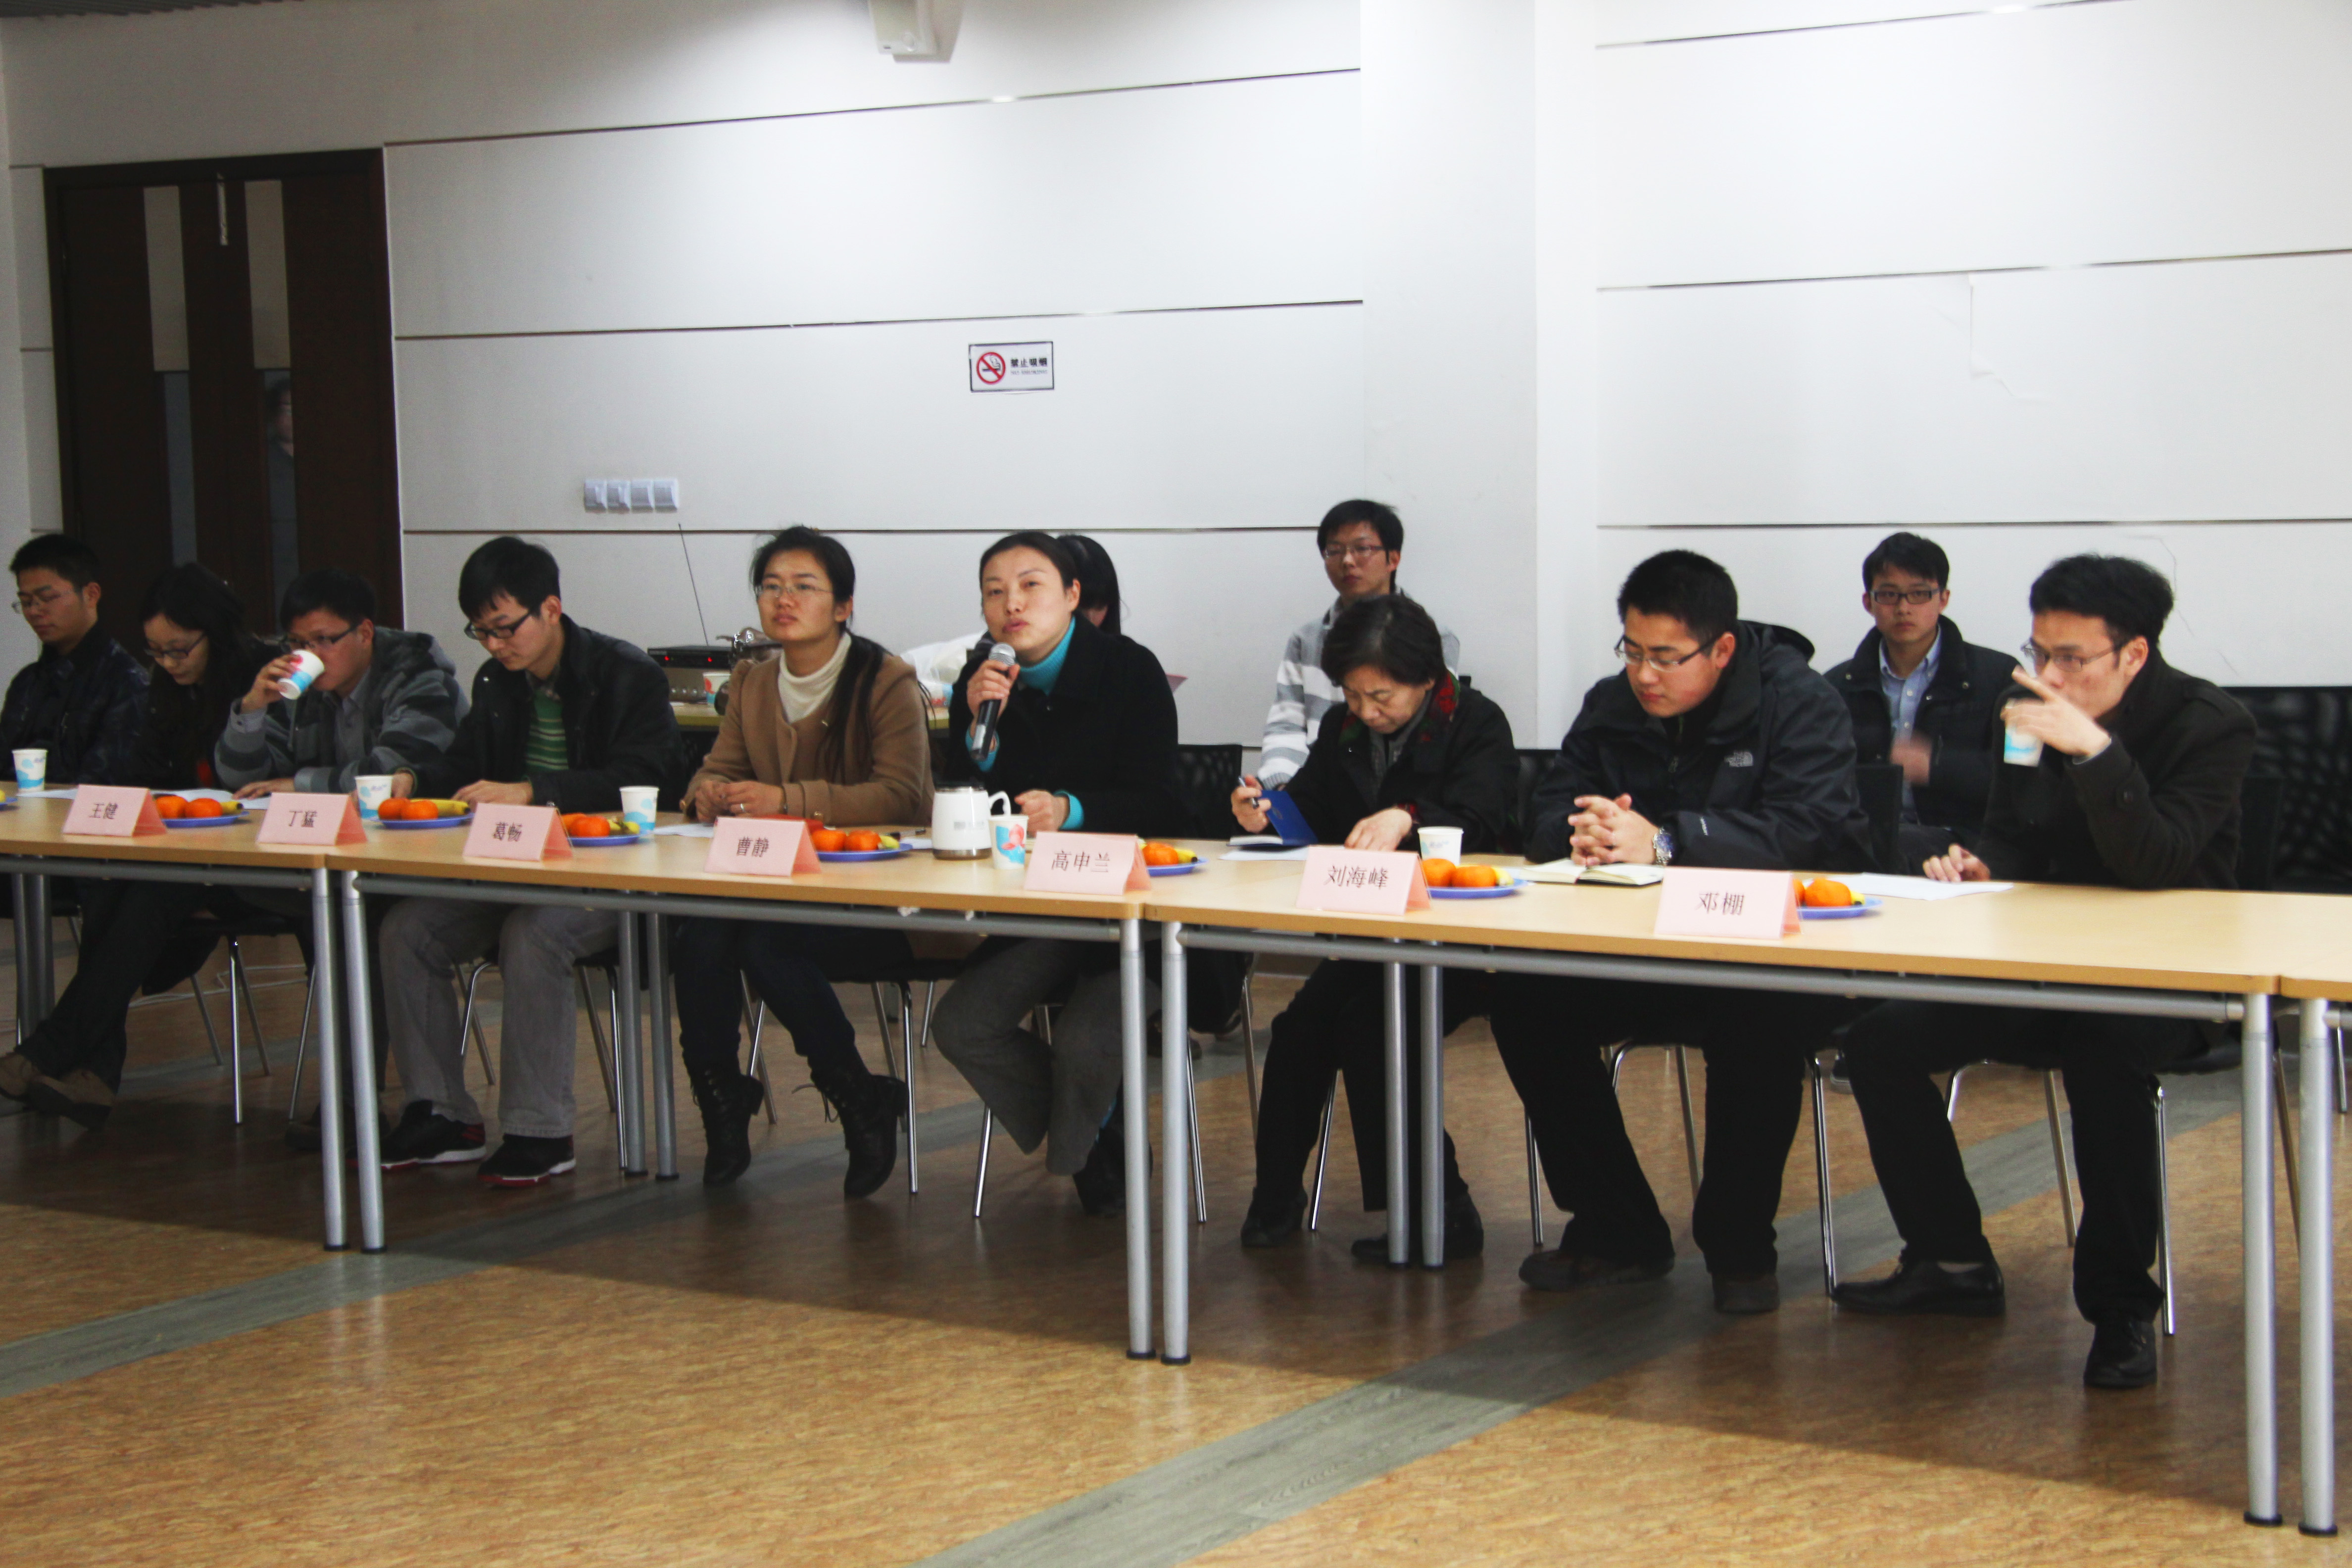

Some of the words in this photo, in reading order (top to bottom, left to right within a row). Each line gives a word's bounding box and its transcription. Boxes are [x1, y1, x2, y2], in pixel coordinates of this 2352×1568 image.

[89, 803, 118, 820] 王健
[289, 810, 317, 828] 丁猛
[736, 836, 769, 857] 曹静
[1051, 849, 1110, 873] 高申兰
[1323, 865, 1389, 889] 刘海峰
[1694, 892, 1745, 915] 邓棚
